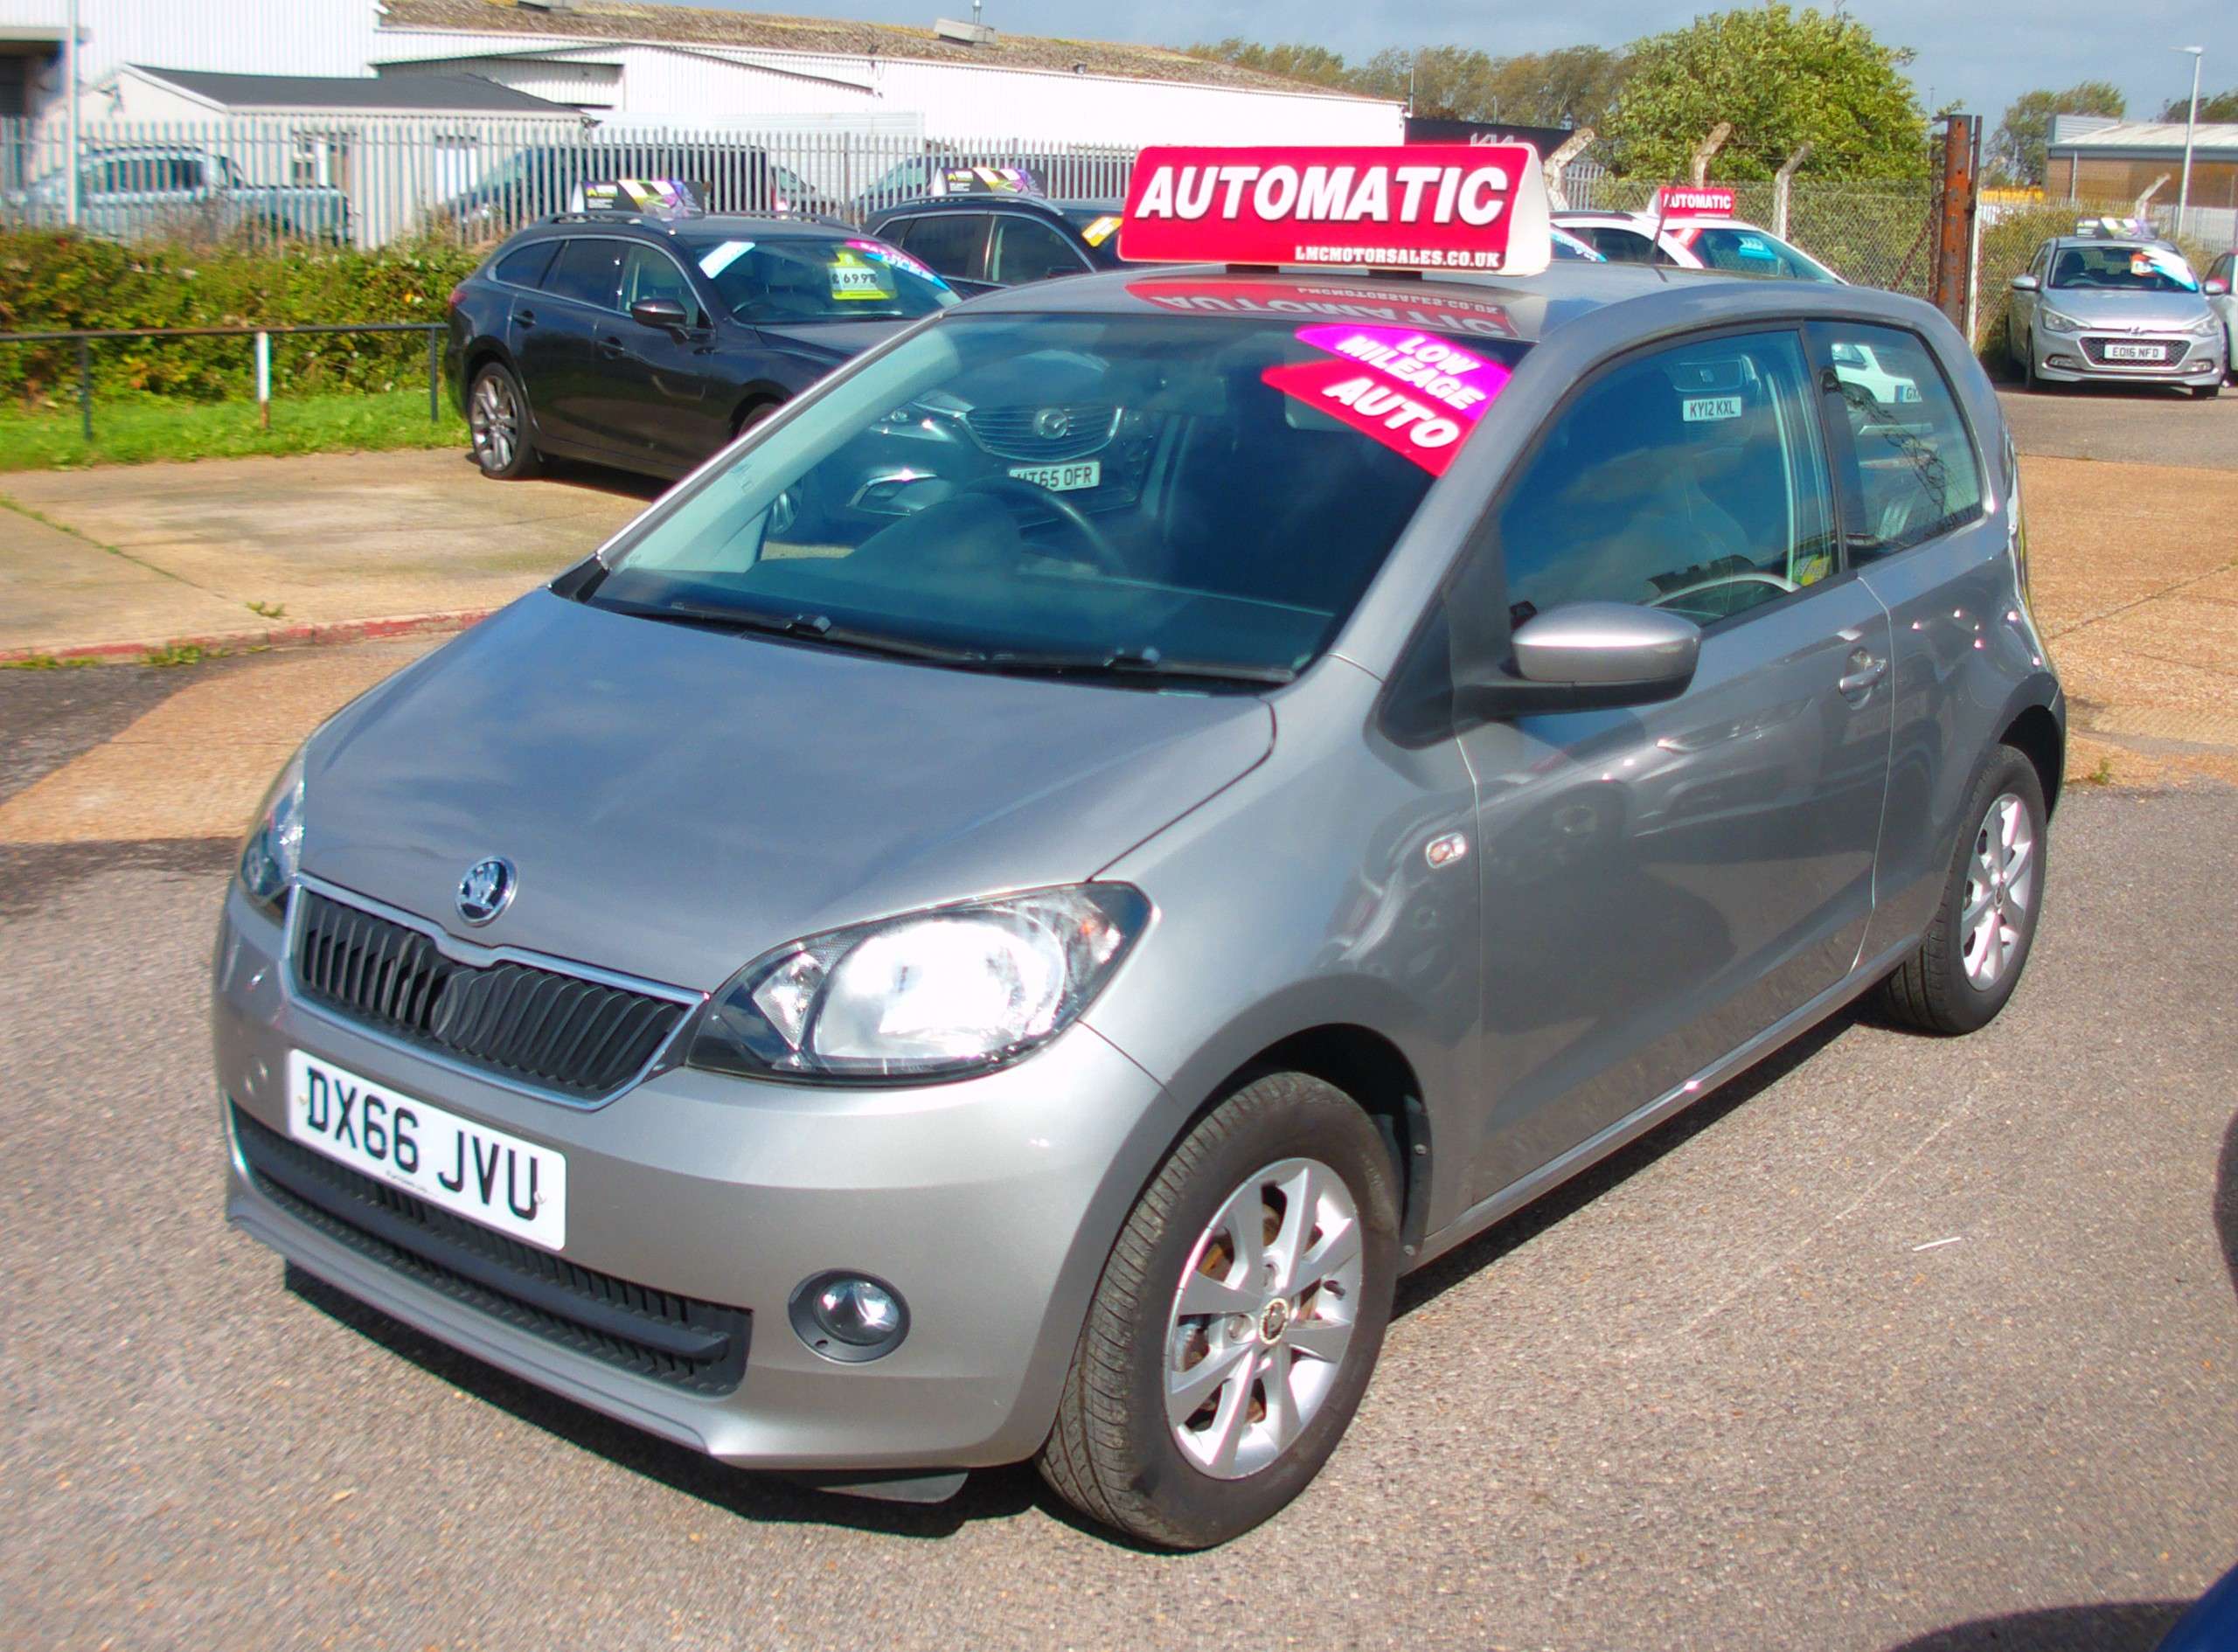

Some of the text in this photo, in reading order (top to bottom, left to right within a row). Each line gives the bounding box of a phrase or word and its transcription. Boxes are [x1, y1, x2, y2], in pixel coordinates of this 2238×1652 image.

[1136, 165, 1507, 226] AUTOMATIC
[1295, 246, 1500, 267] LMCMOTORSALES.CO.UK
[1335, 335, 1486, 410] MILEAGE
[1396, 336, 1482, 376] LOW
[1321, 377, 1460, 448] AUTO
[1690, 400, 1734, 417] KY12 KXL
[1063, 466, 1092, 486] OFR
[307, 1066, 538, 1221] DX66 JVU
